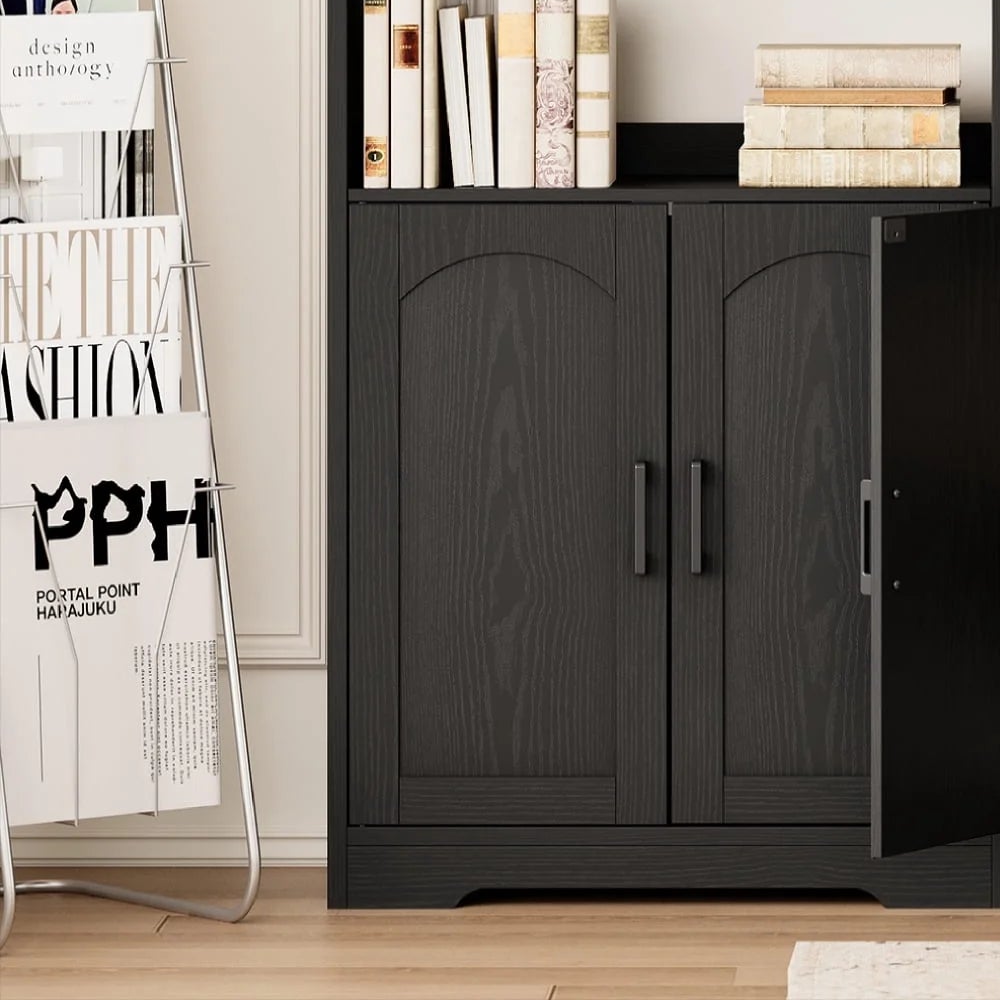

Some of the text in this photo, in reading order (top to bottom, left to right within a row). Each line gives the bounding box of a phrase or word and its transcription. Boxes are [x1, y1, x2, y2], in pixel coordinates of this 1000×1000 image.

[28, 37, 96, 59] design
[68, 226, 169, 339] THE
[30, 475, 215, 571] PPH
[36, 582, 141, 605] PORTAL POINT
[36, 600, 117, 621] HARAJUKU
